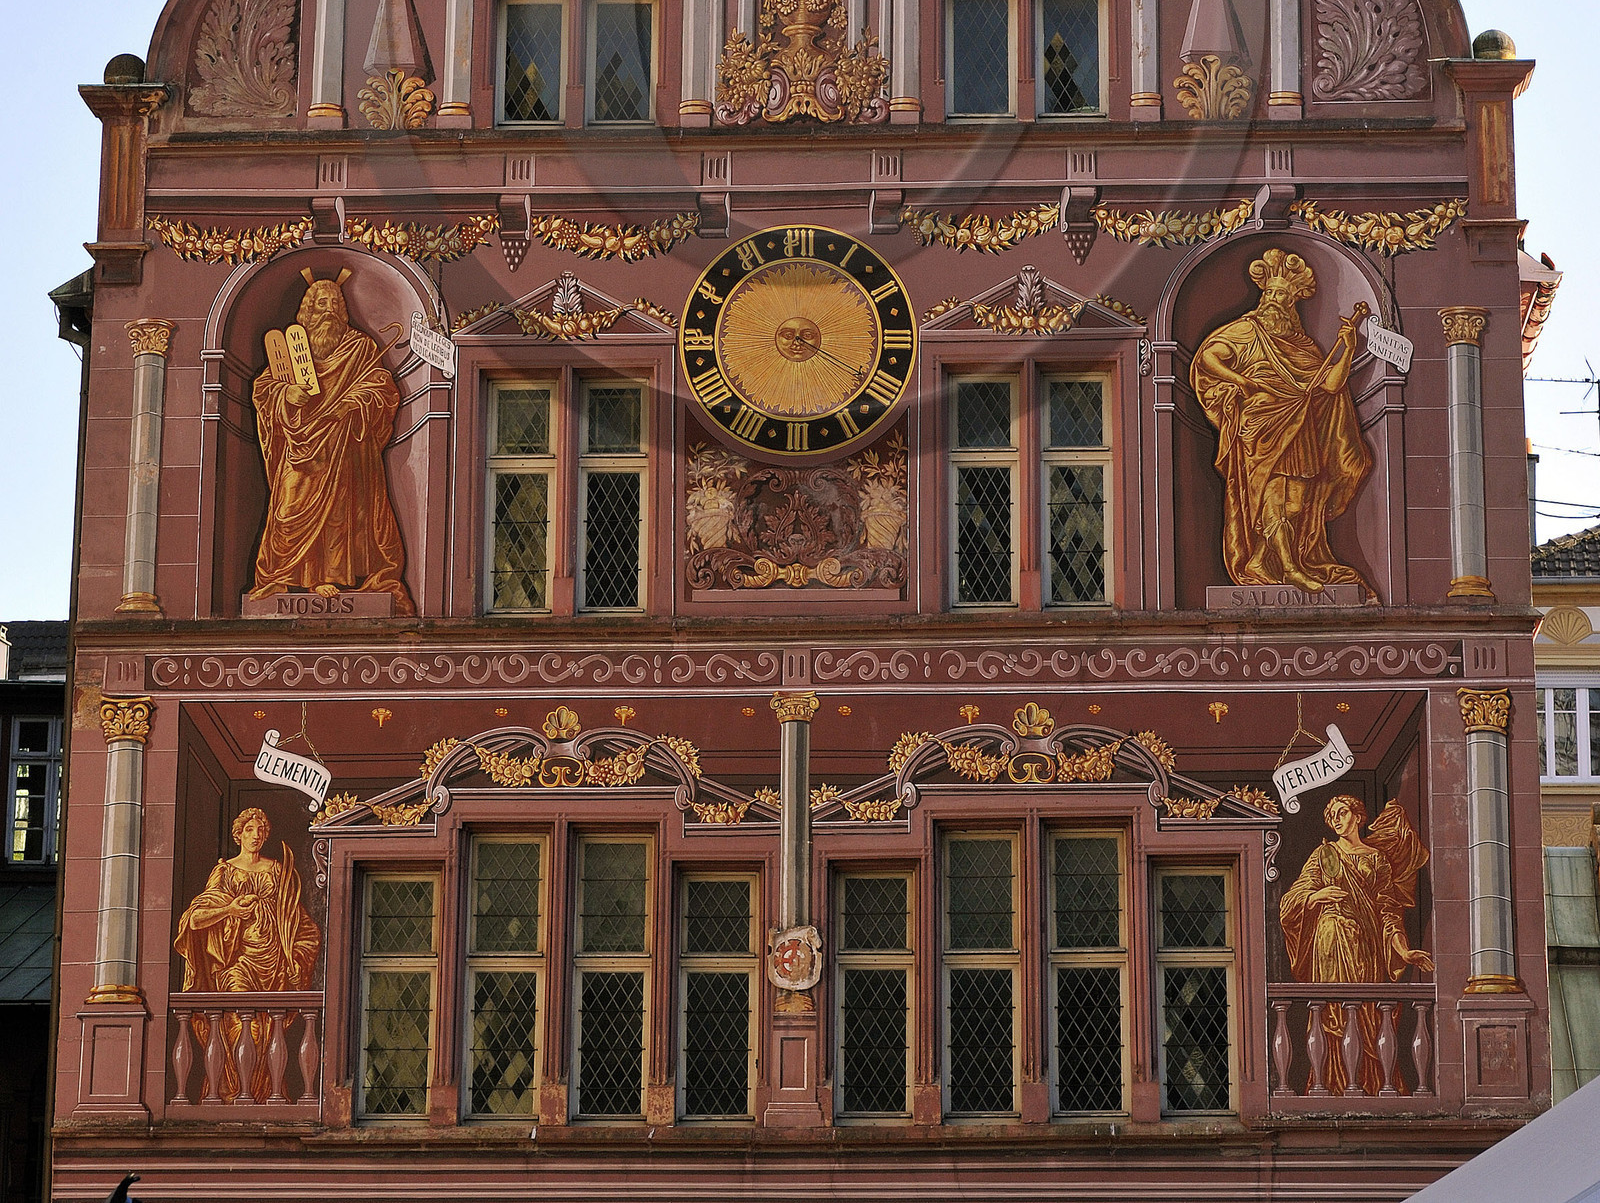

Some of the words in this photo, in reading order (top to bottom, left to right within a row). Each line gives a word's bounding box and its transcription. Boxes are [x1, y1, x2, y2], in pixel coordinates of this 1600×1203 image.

[840, 244, 859, 268] I
[871, 280, 898, 303] II
[290, 331, 303, 341] VI.
[883, 329, 912, 350] III
[1372, 329, 1409, 355] VANITAS
[293, 343, 307, 353] VII.
[294, 354, 311, 365] VIII.
[1369, 341, 1405, 367] VANITUM
[276, 597, 355, 615] MOSES
[256, 751, 328, 798] CLEMENTIA
[1276, 750, 1344, 795] VERITAS
